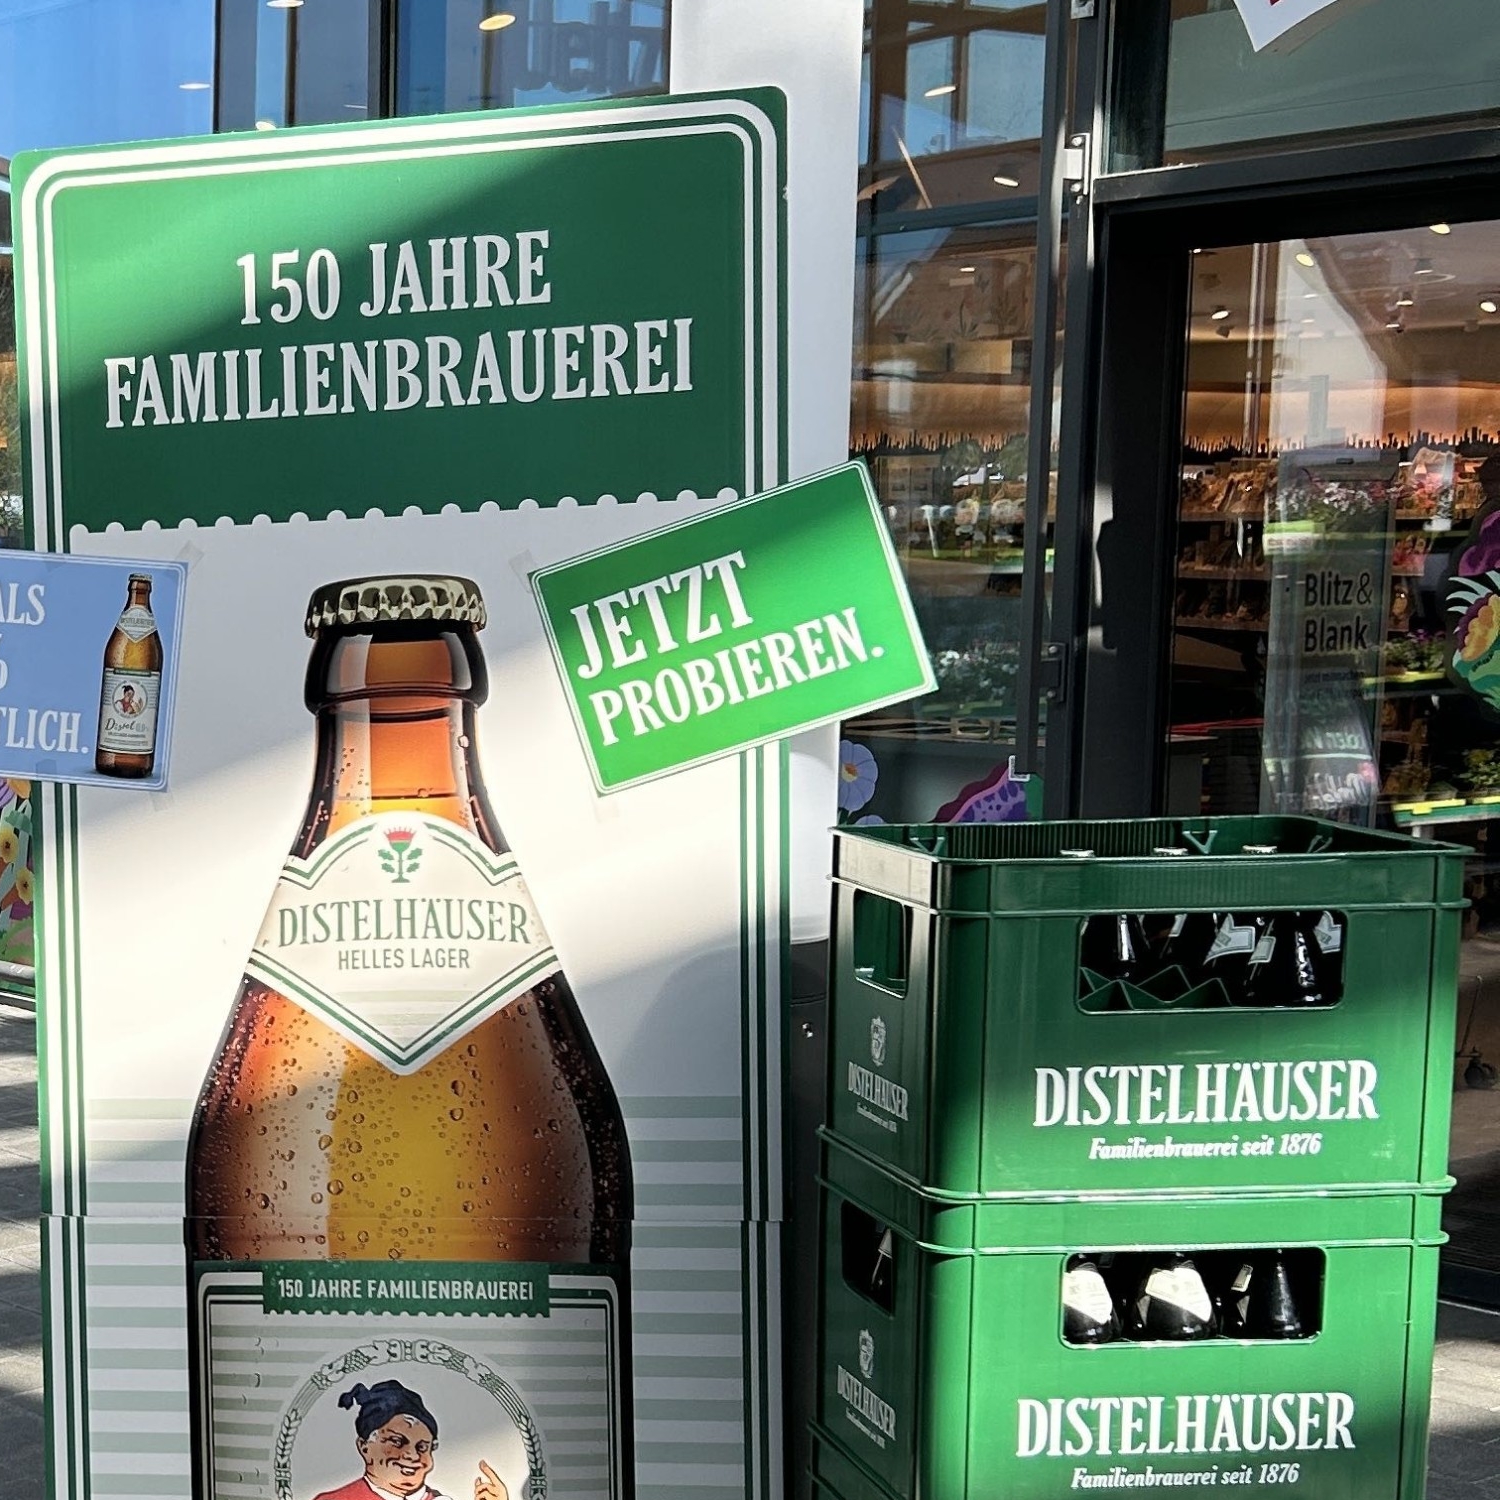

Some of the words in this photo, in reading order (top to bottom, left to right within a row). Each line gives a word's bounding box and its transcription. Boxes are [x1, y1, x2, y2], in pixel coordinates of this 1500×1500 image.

[236, 248, 340, 325] 150
[360, 229, 552, 317] JAHRE
[104, 318, 693, 428] FAMILIENBRAUEREI
[1304, 571, 1353, 607] Blitz
[570, 550, 754, 679] JETZT
[1304, 616, 1368, 653] Blank
[588, 606, 885, 746] PROBIEREN.
[278, 898, 531, 948] DISTELHÄUSER
[338, 949, 405, 971] HELLES
[410, 949, 470, 970] LAGER
[1033, 1060, 1379, 1127] DISTELHÄUSER
[1088, 1133, 1240, 1161] Familienbrauerei
[1242, 1134, 1275, 1157] seit
[1278, 1131, 1322, 1156] 1876
[278, 1279, 303, 1298] 150
[308, 1279, 362, 1299] JAHRE
[367, 1279, 534, 1301] FAMILIENBRAUEREI
[1016, 1393, 1355, 1457] DISTELHÄUSER
[1071, 1465, 1217, 1490] Familienbrauerei
[1221, 1466, 1253, 1486] seit
[1258, 1462, 1300, 1484] 1876
